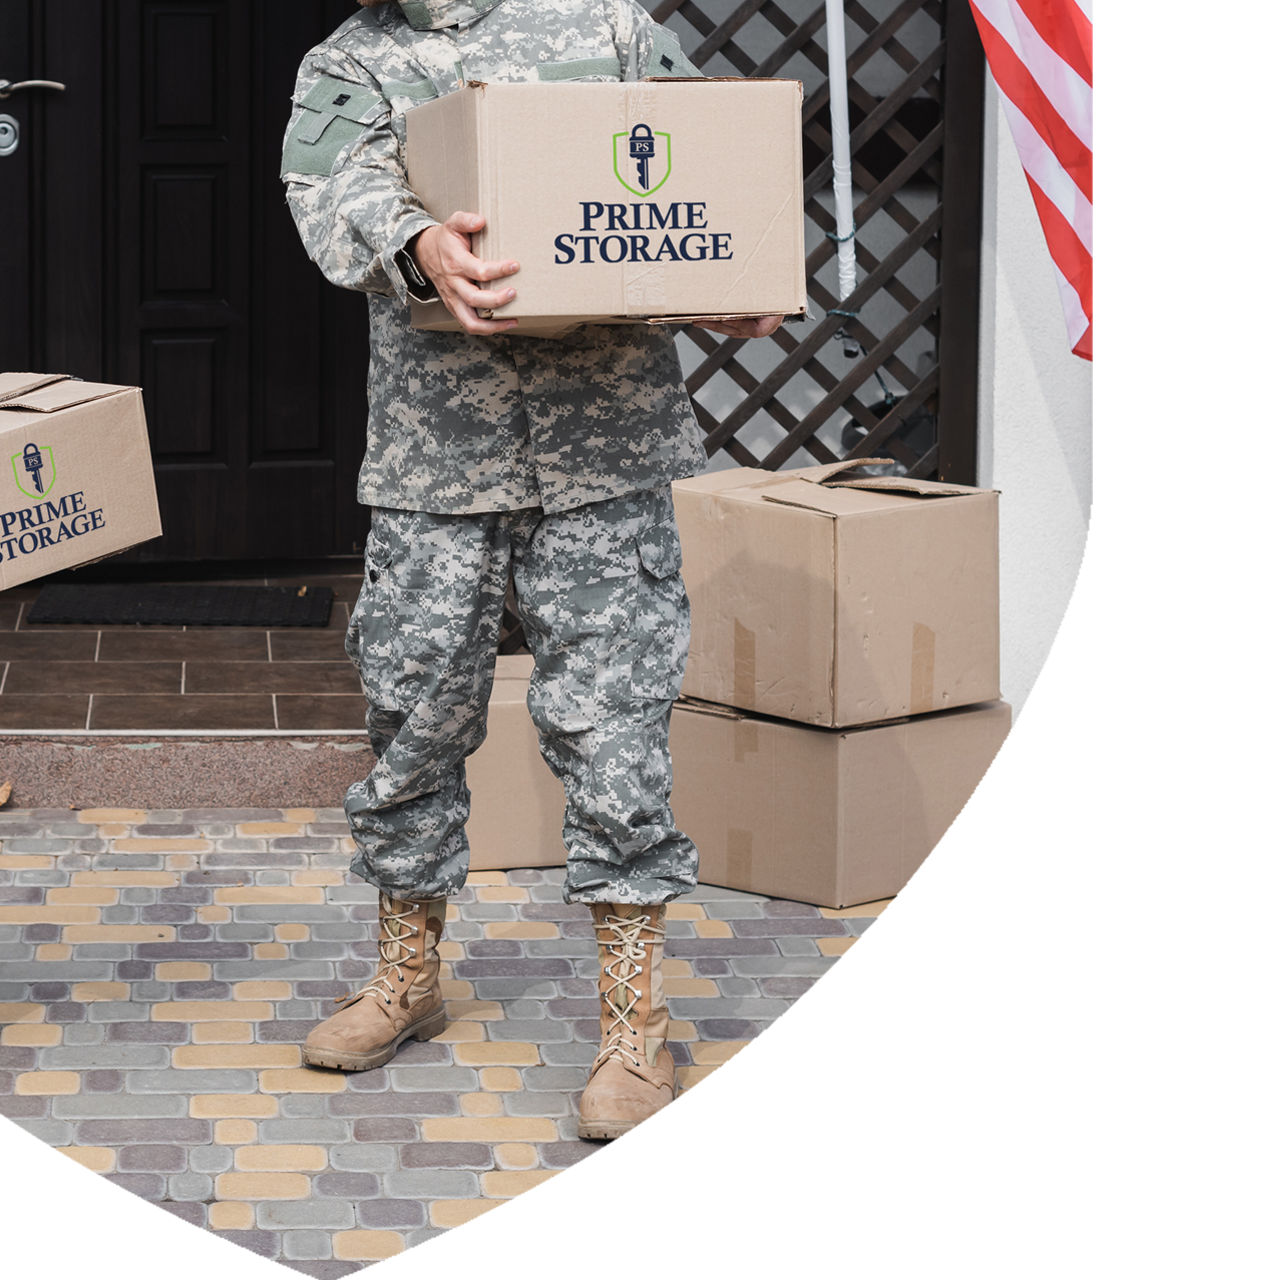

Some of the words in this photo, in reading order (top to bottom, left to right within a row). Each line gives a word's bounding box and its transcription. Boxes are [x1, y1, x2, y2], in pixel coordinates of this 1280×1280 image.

[634, 142, 650, 152] PS
[578, 201, 709, 231] PRIME
[553, 233, 734, 265] STORAGE
[27, 457, 39, 467] PS
